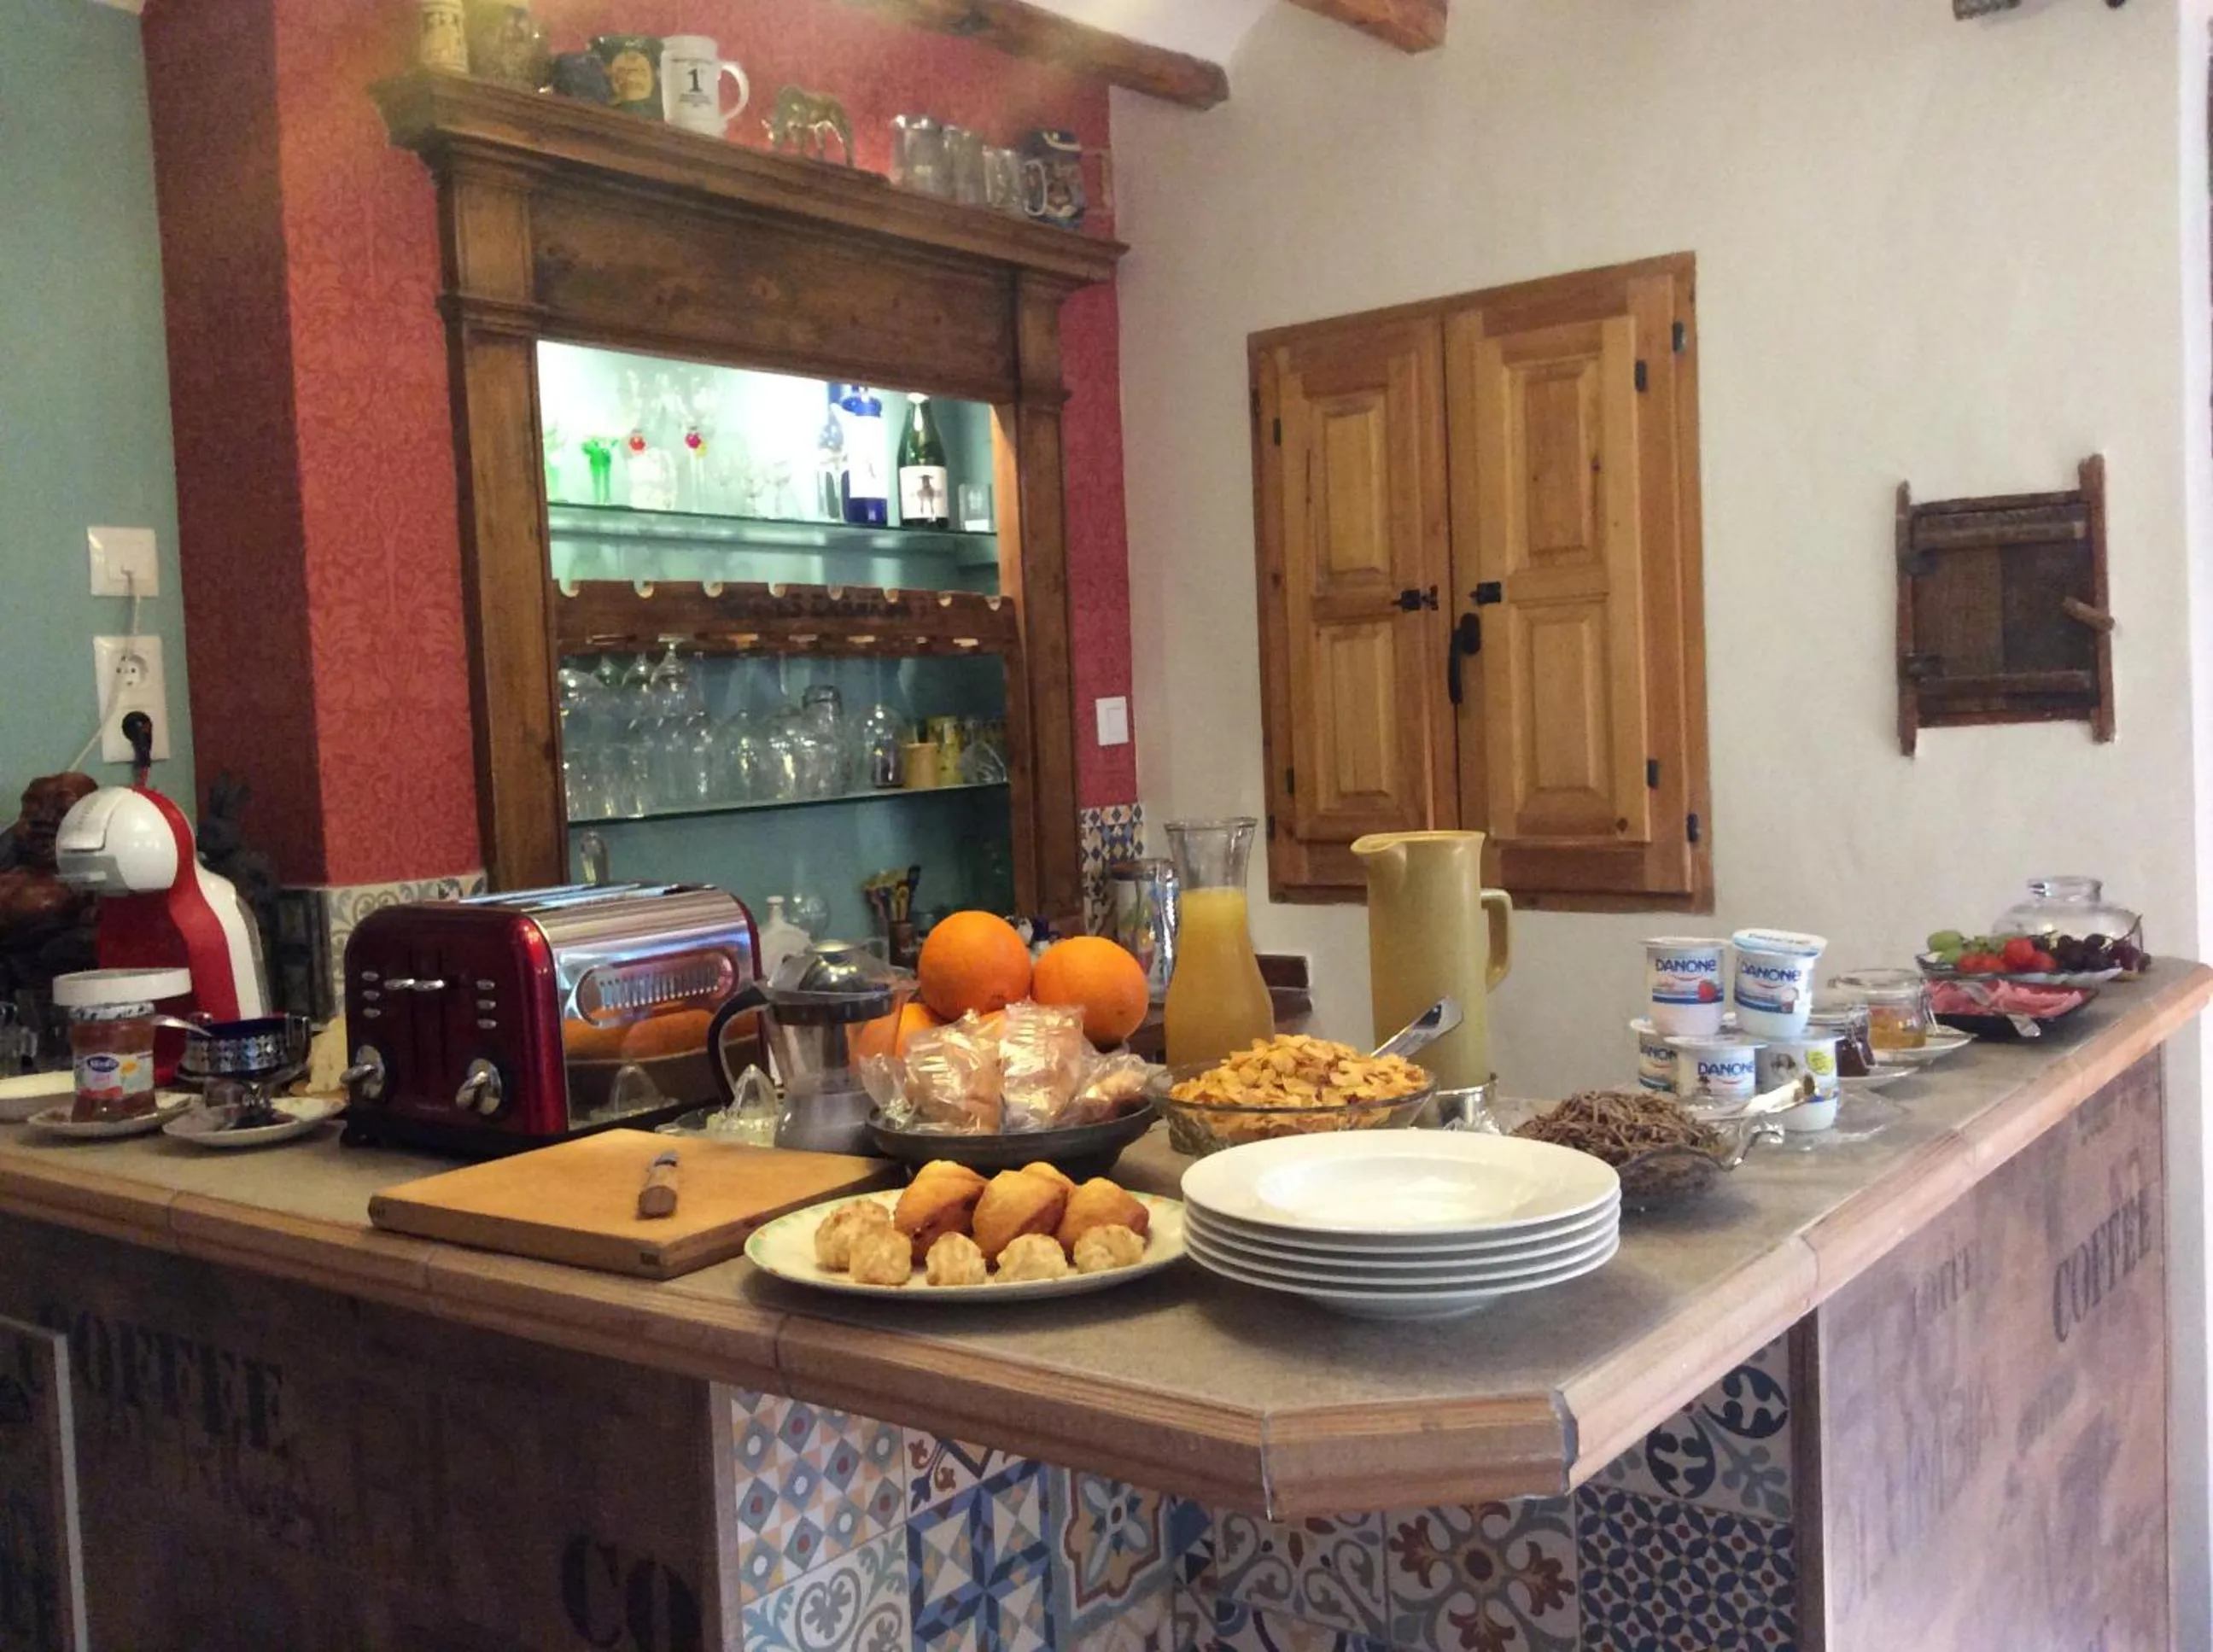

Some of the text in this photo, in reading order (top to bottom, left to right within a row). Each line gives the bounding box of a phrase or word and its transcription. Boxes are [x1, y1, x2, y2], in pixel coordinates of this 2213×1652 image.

[687, 69, 704, 92] 1
[1655, 959, 1716, 972] DANONE
[1742, 961, 1801, 982] DANONE
[2053, 1188, 2151, 1343] COFFEE
